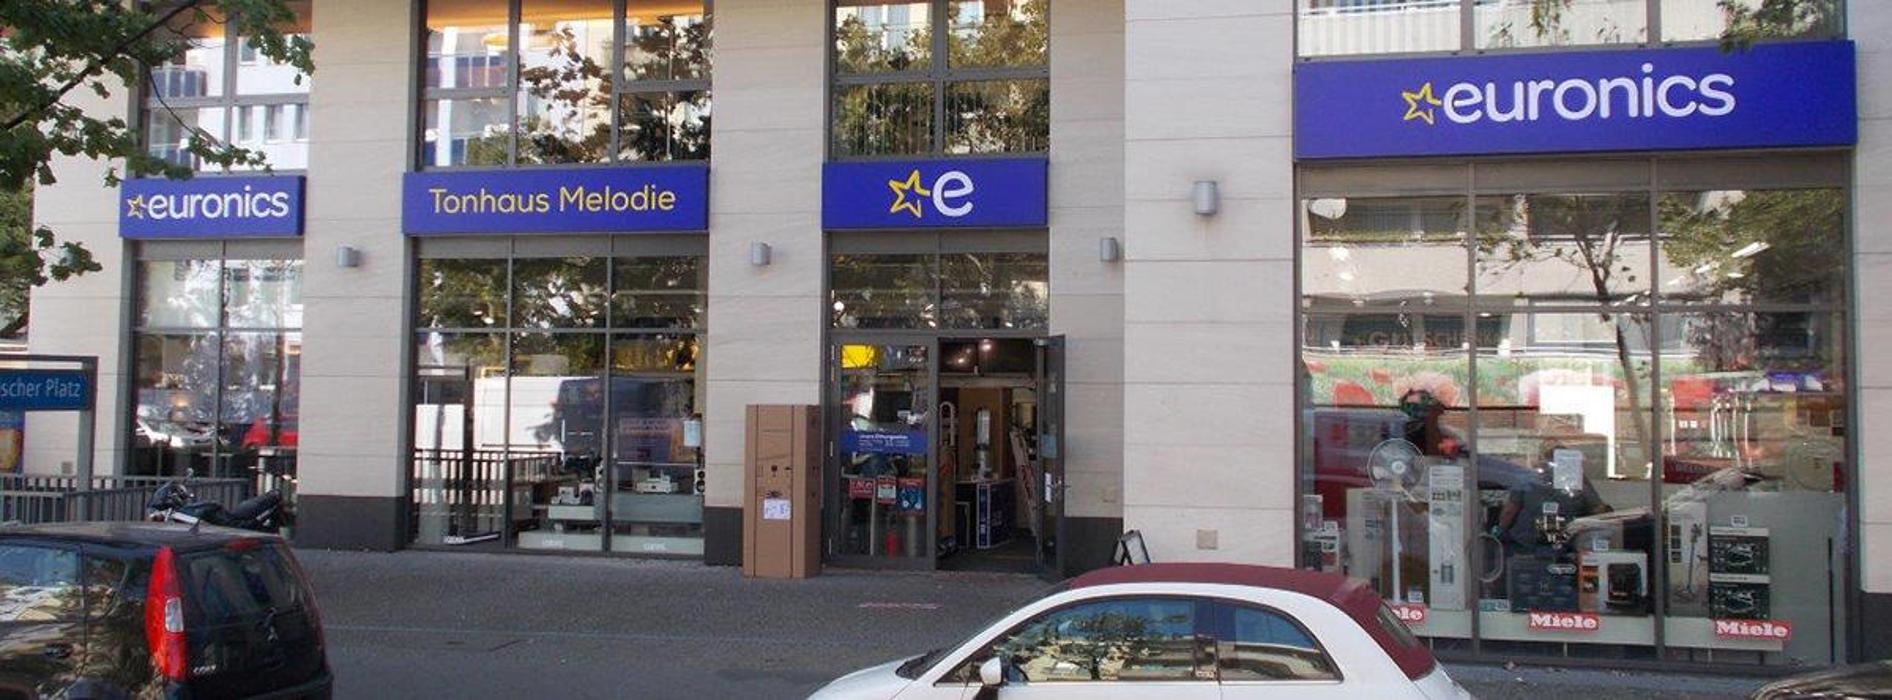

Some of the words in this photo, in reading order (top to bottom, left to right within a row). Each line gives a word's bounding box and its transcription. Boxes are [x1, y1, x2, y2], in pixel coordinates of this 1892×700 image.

[1443, 63, 1735, 124] euronics
[148, 184, 289, 220] euronics
[429, 183, 551, 214] Tonhaus
[559, 183, 677, 213] Melodie
[932, 171, 974, 217] e
[46, 377, 81, 398] Platz
[1529, 612, 1598, 629] Miele
[1716, 619, 1789, 638] Miele
